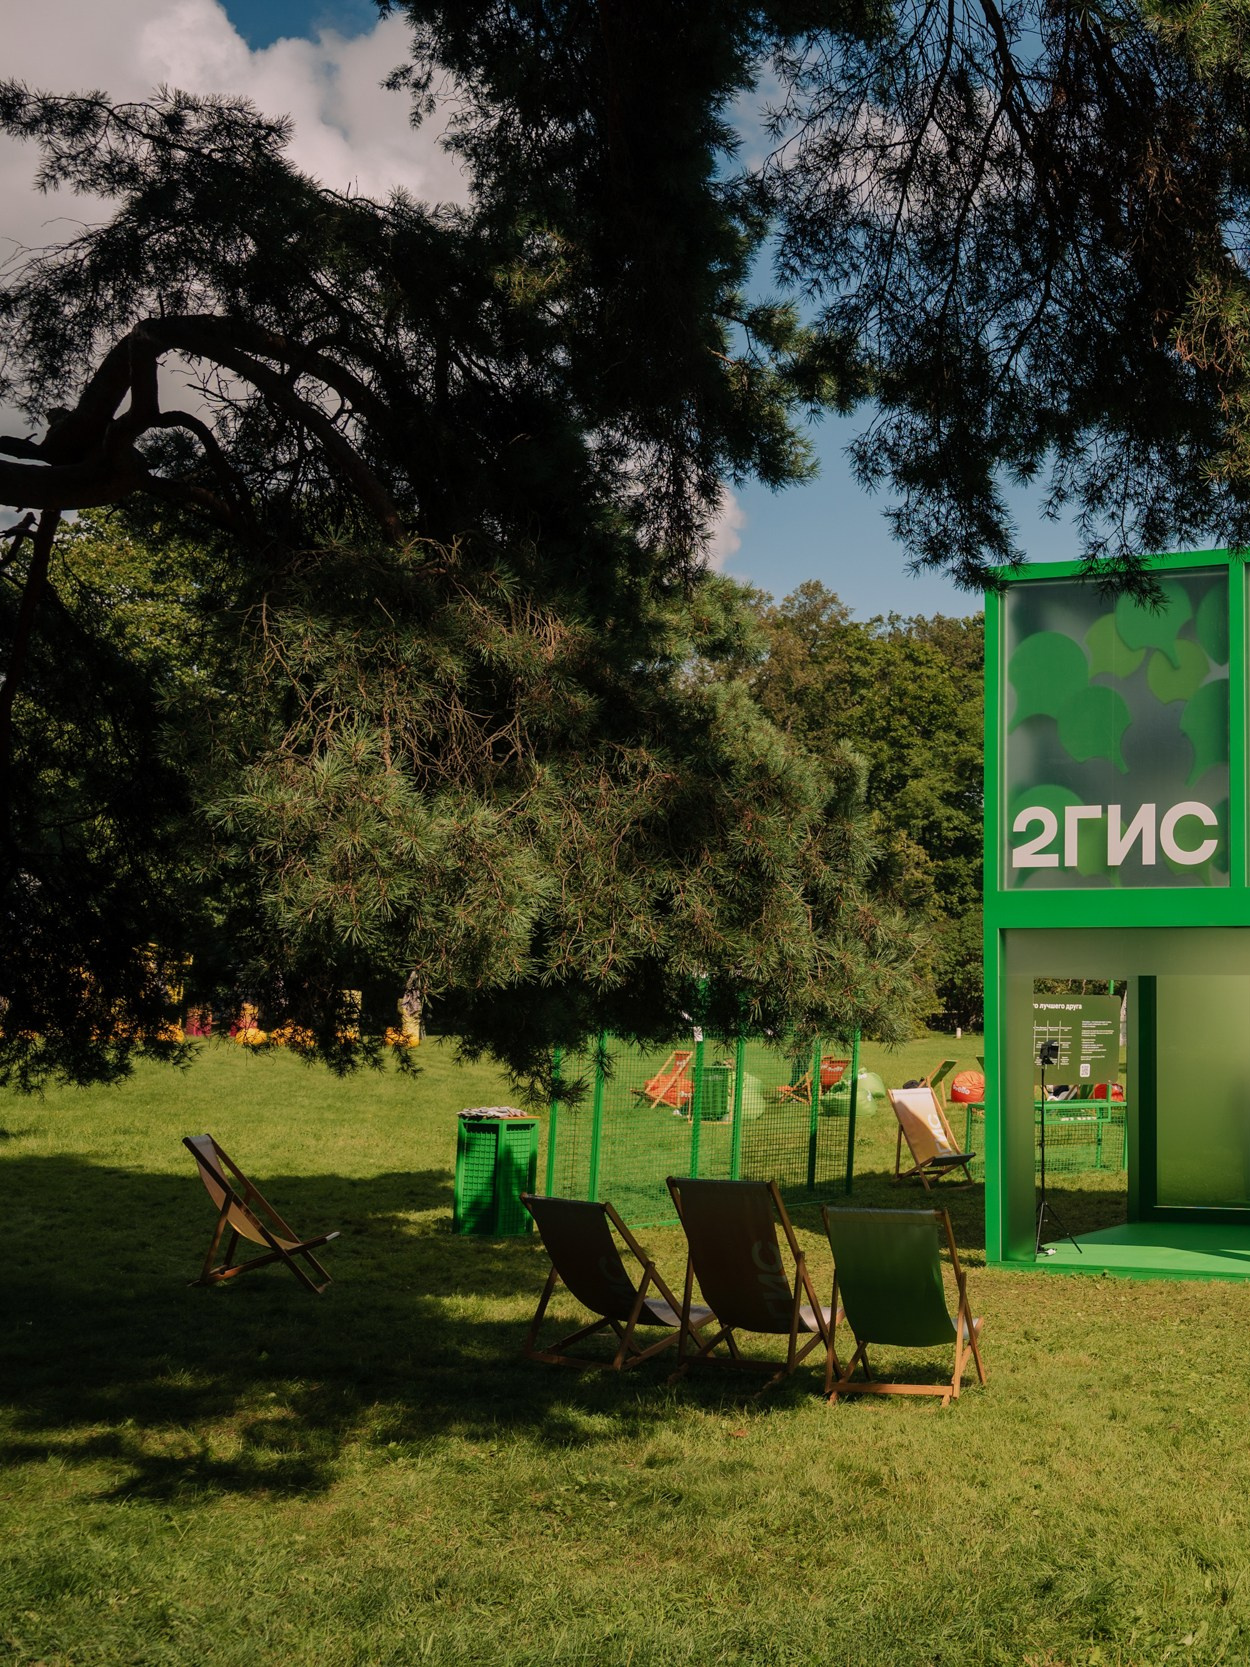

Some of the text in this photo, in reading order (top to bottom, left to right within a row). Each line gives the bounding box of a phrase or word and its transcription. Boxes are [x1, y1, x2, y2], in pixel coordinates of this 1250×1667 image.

[1012, 801, 1219, 868] 2ГИС
[1039, 1003, 1066, 1011] лучшего
[1066, 1003, 1083, 1011] друга
[927, 1114, 952, 1157] ГИС
